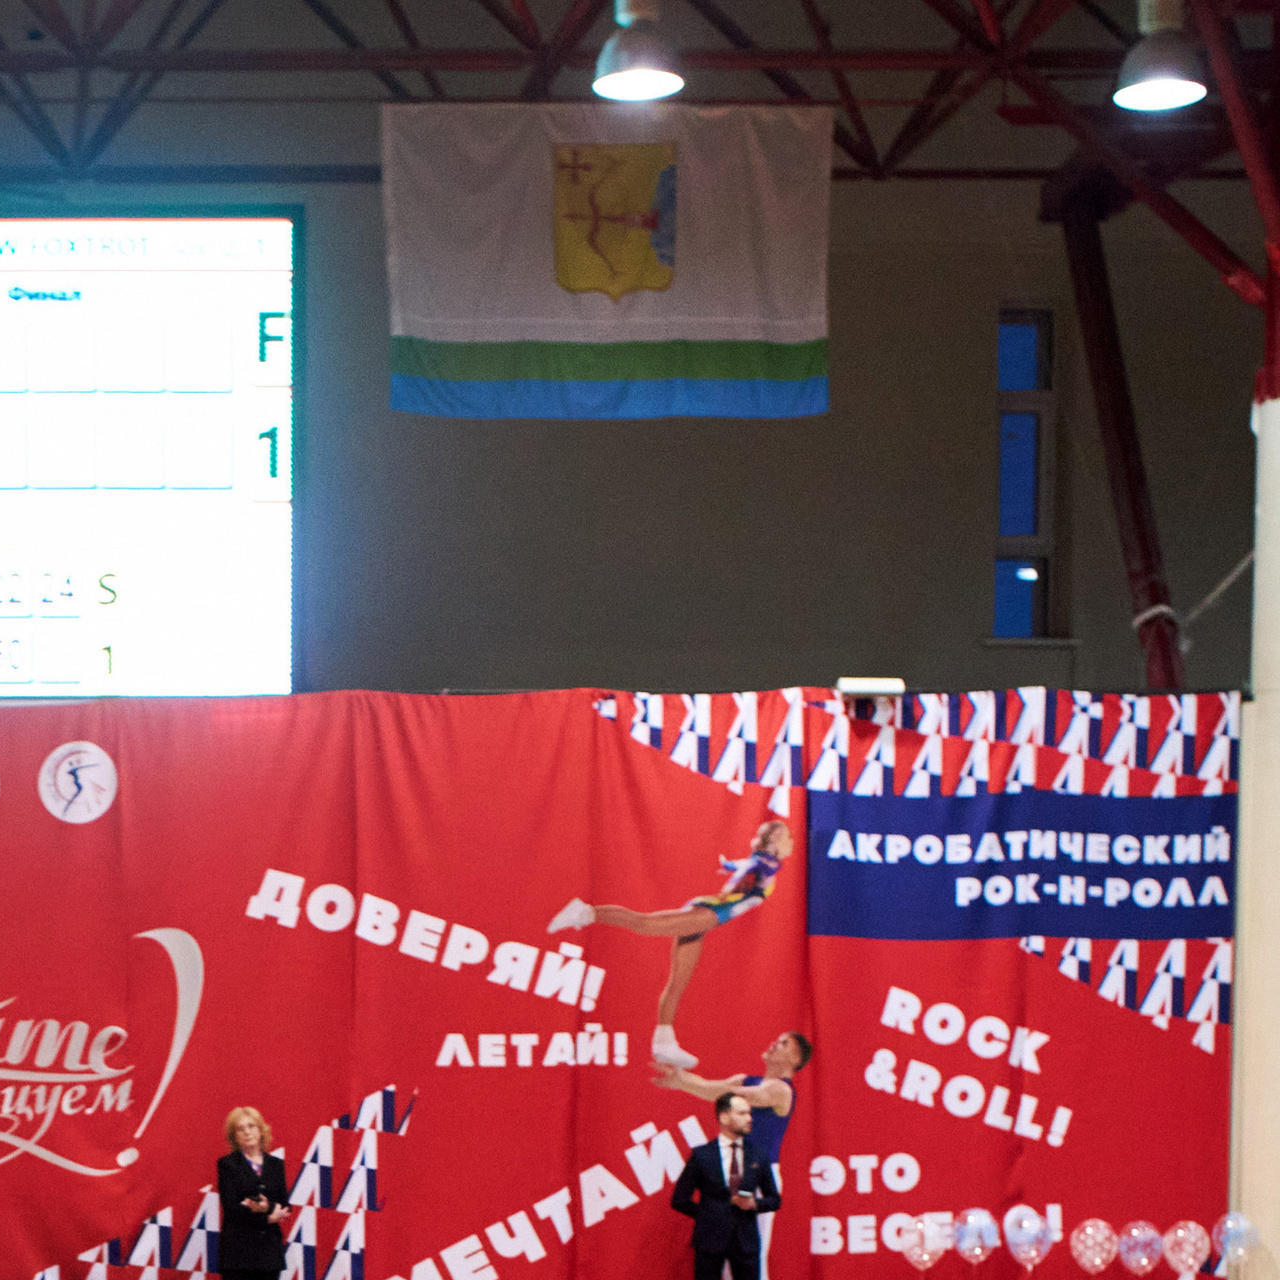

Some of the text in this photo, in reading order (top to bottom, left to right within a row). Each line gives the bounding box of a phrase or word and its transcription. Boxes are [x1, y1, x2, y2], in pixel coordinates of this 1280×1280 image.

[29, 236, 150, 257] FOXTROT
[259, 311, 287, 362] F
[258, 426, 278, 478] 1
[41, 572, 74, 604] 24
[97, 573, 117, 605] S
[101, 644, 112, 675] 1
[827, 826, 1232, 865] АКРОБАТИЧЕСКИЙ
[954, 873, 1229, 908] РОК-Н-РОЛЛ
[245, 868, 607, 1012] ДОВЕРЯЙ!
[435, 1023, 629, 1067] ЛЕТАЙ!
[879, 986, 1051, 1074] ROCK
[863, 1048, 1074, 1148] &ROLL!
[810, 1152, 920, 1196] ЭТО
